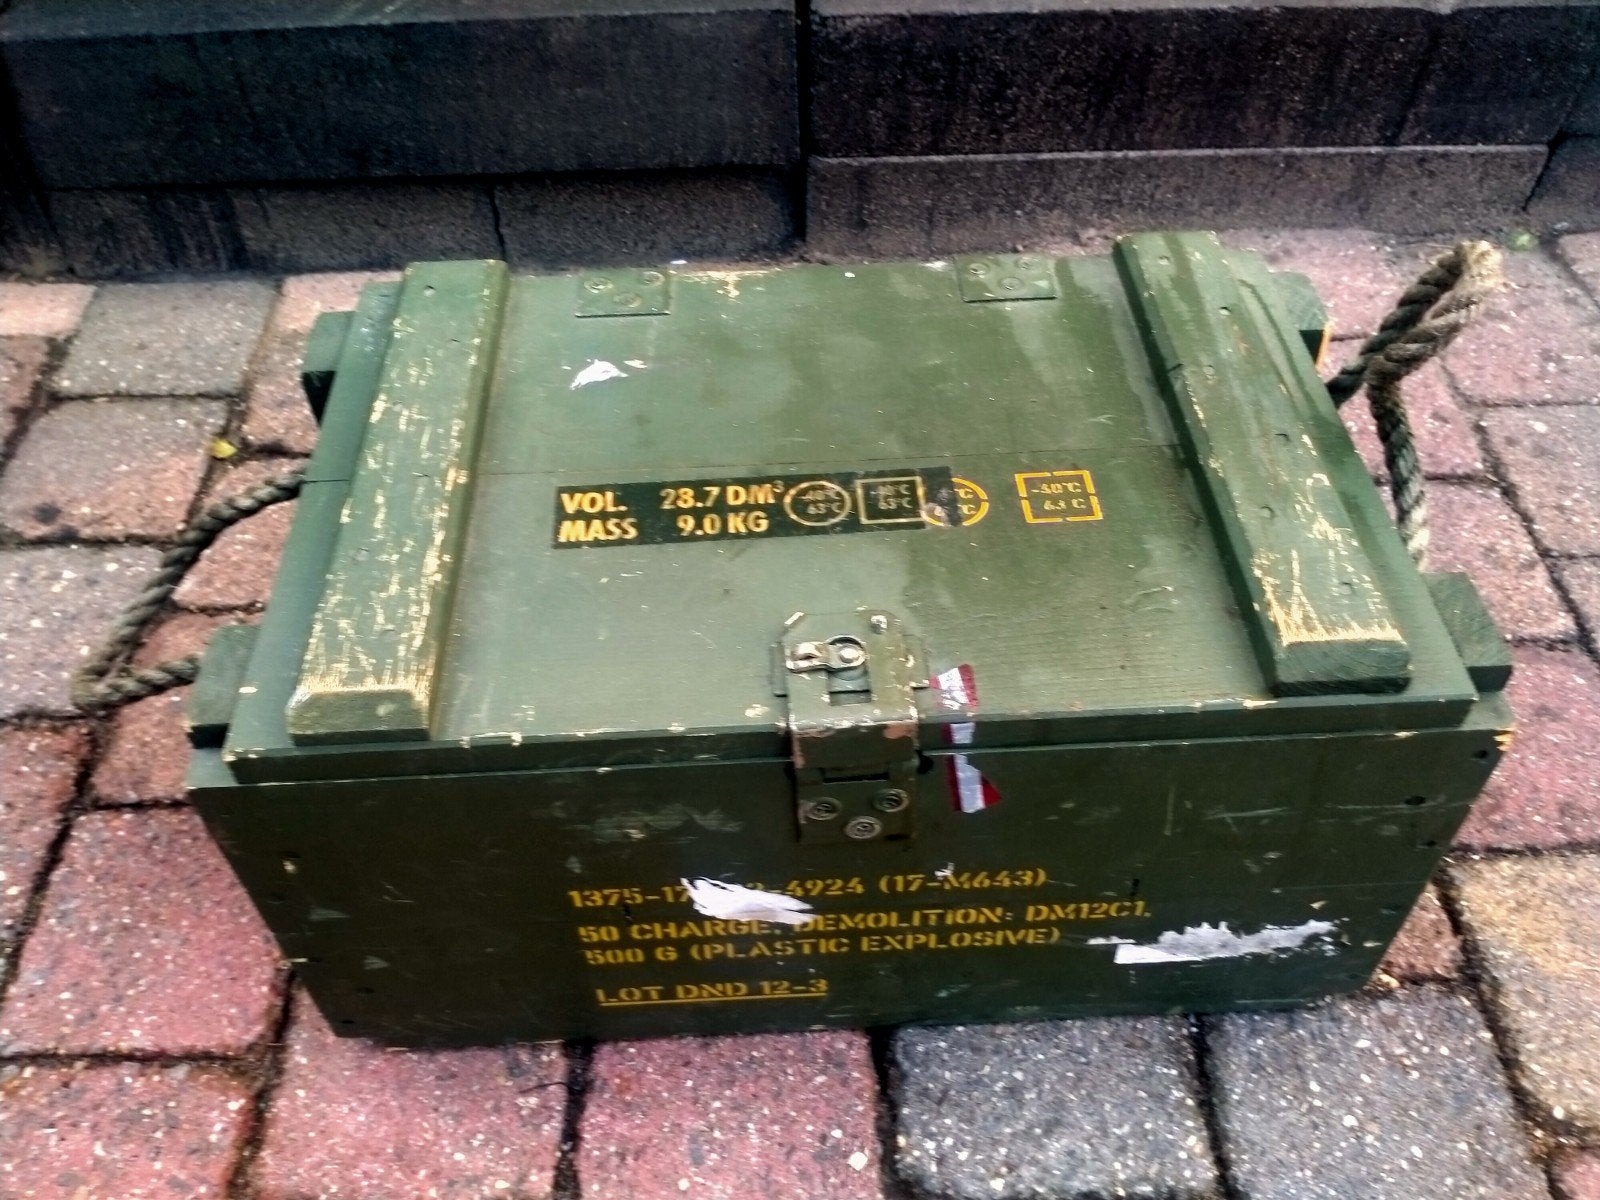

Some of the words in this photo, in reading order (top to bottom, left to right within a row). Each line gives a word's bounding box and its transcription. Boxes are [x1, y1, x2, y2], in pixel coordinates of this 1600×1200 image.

[560, 492, 628, 513] VOL.
[660, 487, 722, 510] 28.7
[558, 518, 638, 543] MASS
[677, 513, 723, 537] 9.0
[727, 511, 770, 535] KG
[578, 926, 620, 943] 50
[584, 948, 645, 965] 500
[653, 946, 678, 962] G
[690, 937, 850, 960] (PLASTIC
[861, 928, 1060, 951] EXPLOSIVE)
[596, 986, 664, 1003] LOT
[677, 982, 749, 999] DND
[760, 979, 828, 996] 12-3
